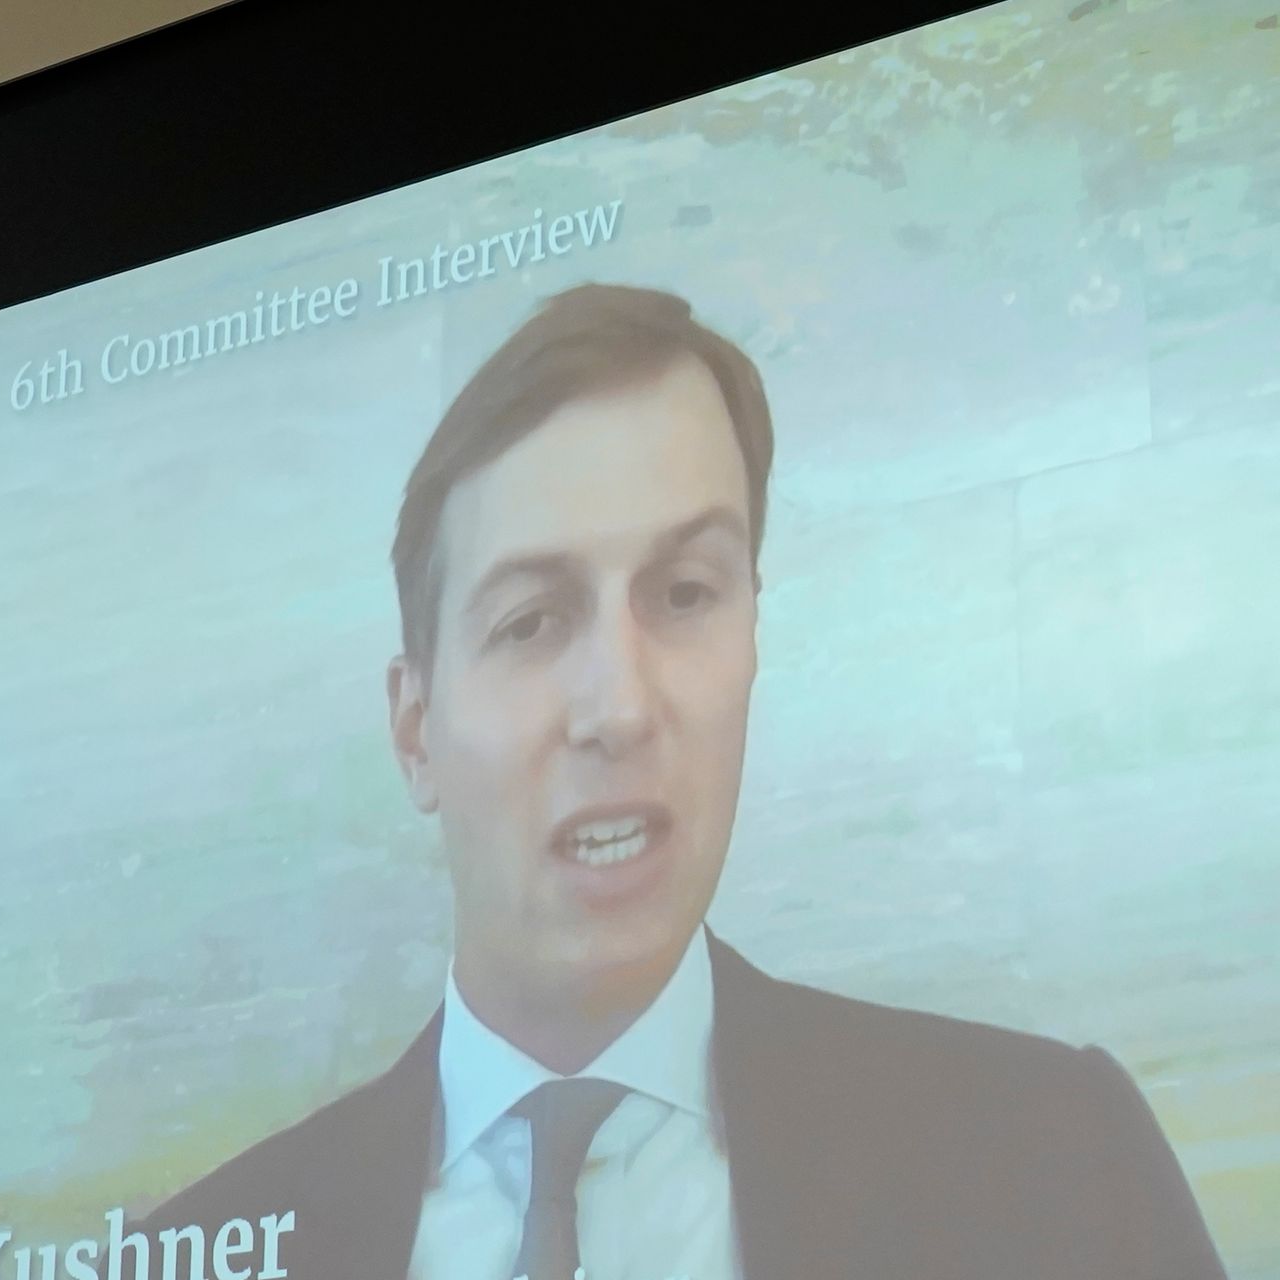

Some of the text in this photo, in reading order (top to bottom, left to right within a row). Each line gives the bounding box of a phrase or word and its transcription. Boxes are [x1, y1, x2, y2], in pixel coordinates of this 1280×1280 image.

[10, 348, 85, 411] 6th
[100, 276, 359, 384] Committee
[376, 200, 622, 308] Interview
